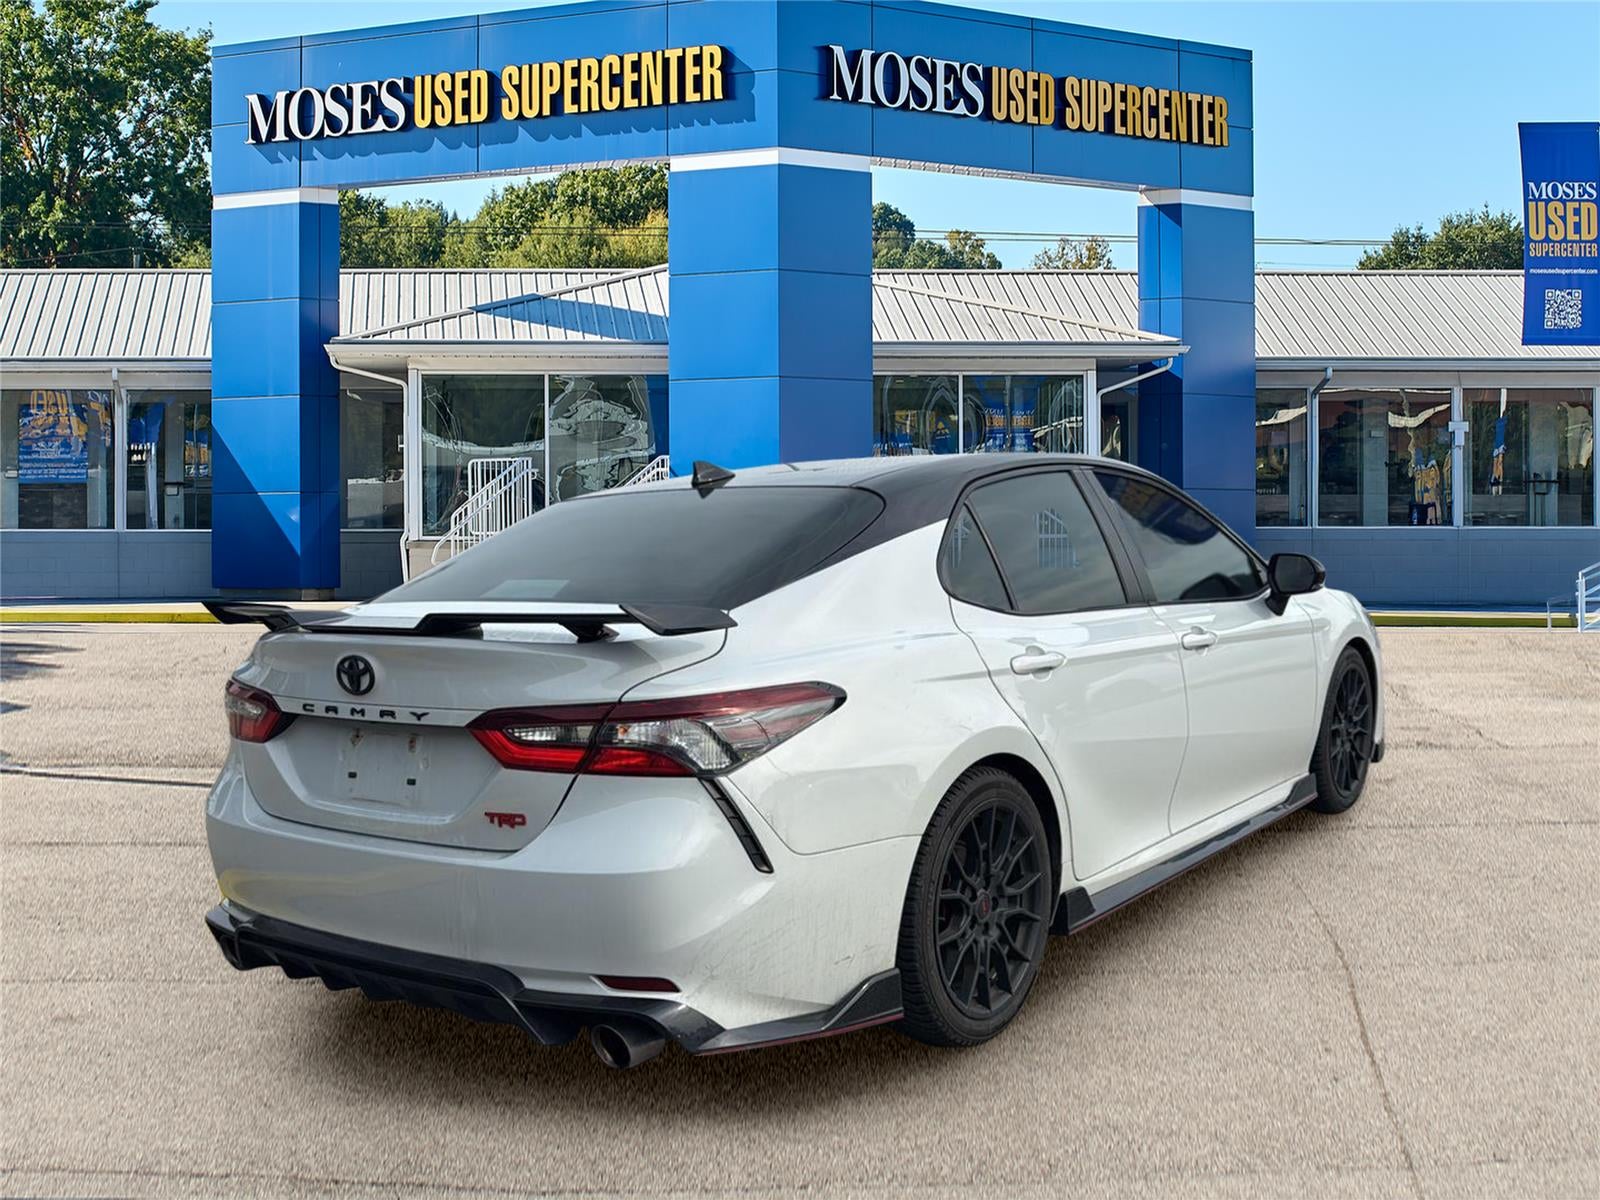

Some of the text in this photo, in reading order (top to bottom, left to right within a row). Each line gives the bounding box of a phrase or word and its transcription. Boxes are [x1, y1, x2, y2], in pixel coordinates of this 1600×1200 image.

[244, 44, 724, 144] MOSES USED SUPERCENTER
[829, 44, 1229, 147] MOSES USED SUPERCENTER
[1527, 181, 1598, 200] MOSES
[1528, 201, 1599, 241] USED
[1529, 243, 1599, 257] SUPERCENTER
[302, 702, 430, 721] CAMRY
[484, 811, 527, 829] TRD
